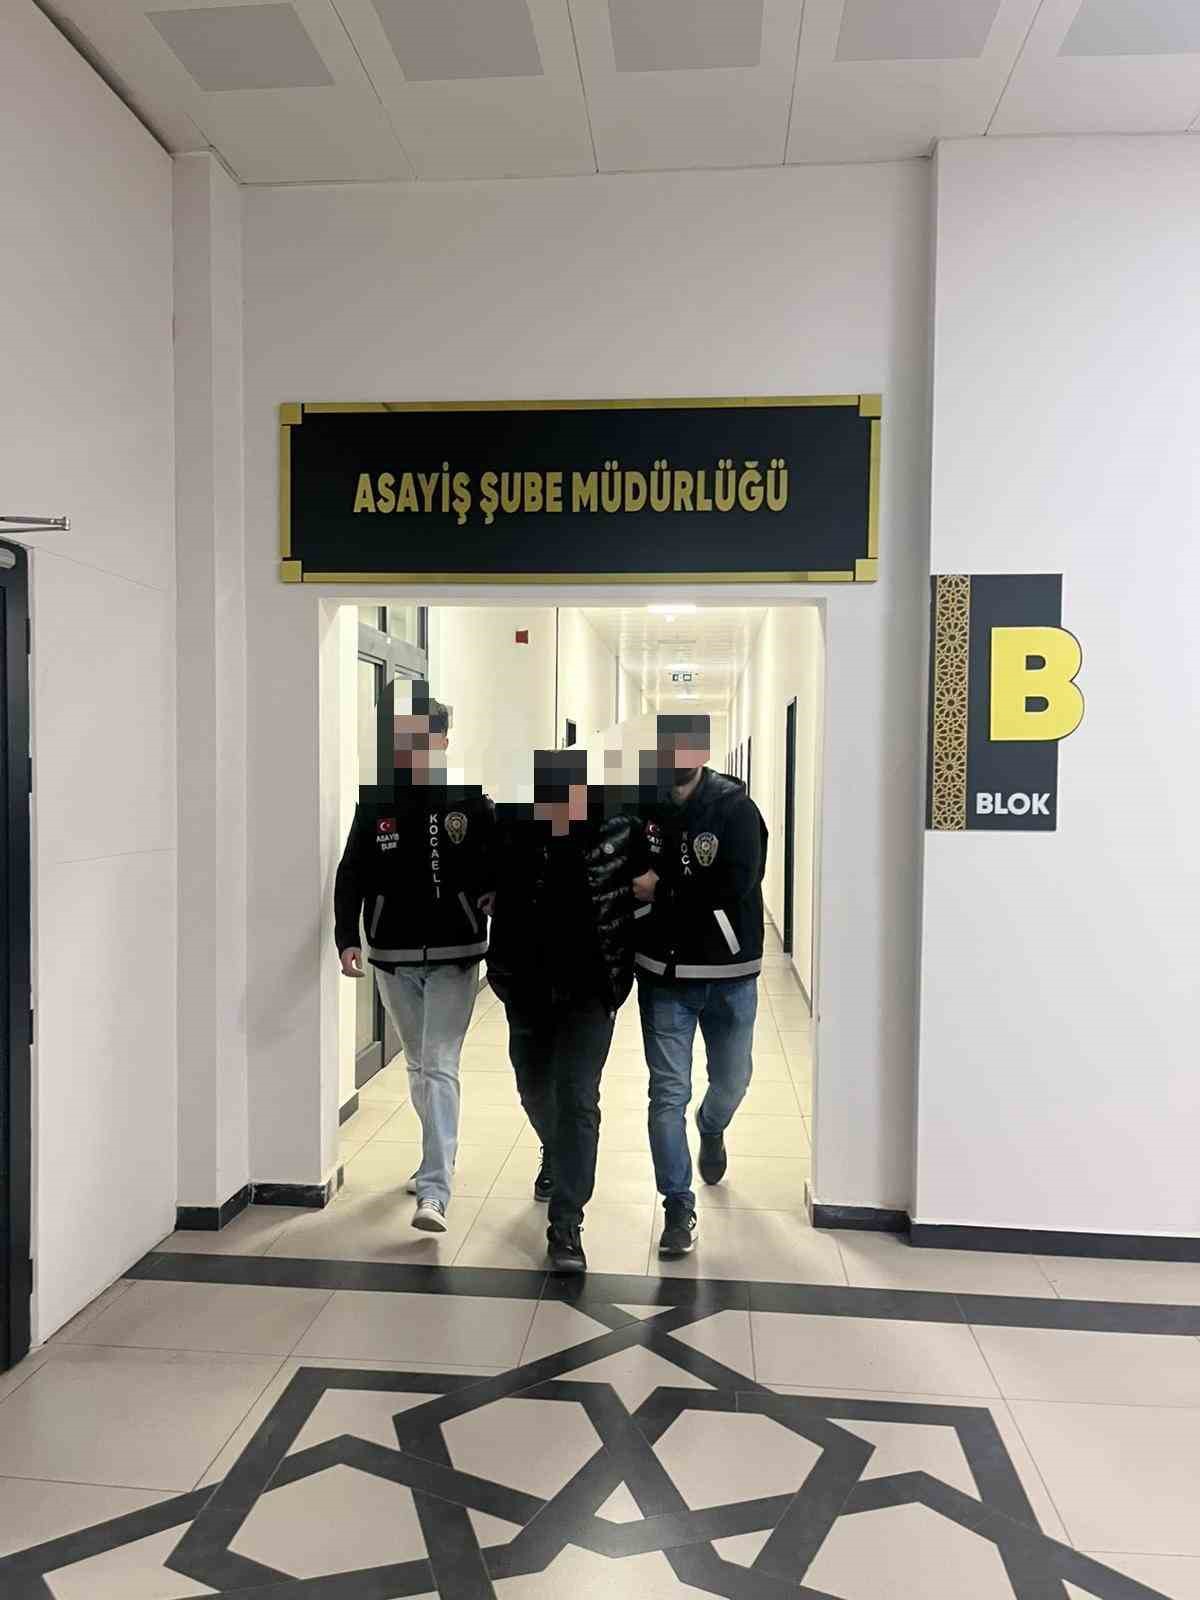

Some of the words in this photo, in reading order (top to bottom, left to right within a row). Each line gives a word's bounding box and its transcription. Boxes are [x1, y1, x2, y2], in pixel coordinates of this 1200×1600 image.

[353, 461, 471, 525] ASAYİŞ
[479, 472, 563, 525] ŞUBE
[571, 458, 789, 513] MÜDÜRLÜĞÜ
[989, 626, 1085, 742] B
[976, 792, 1051, 816] BLOK
